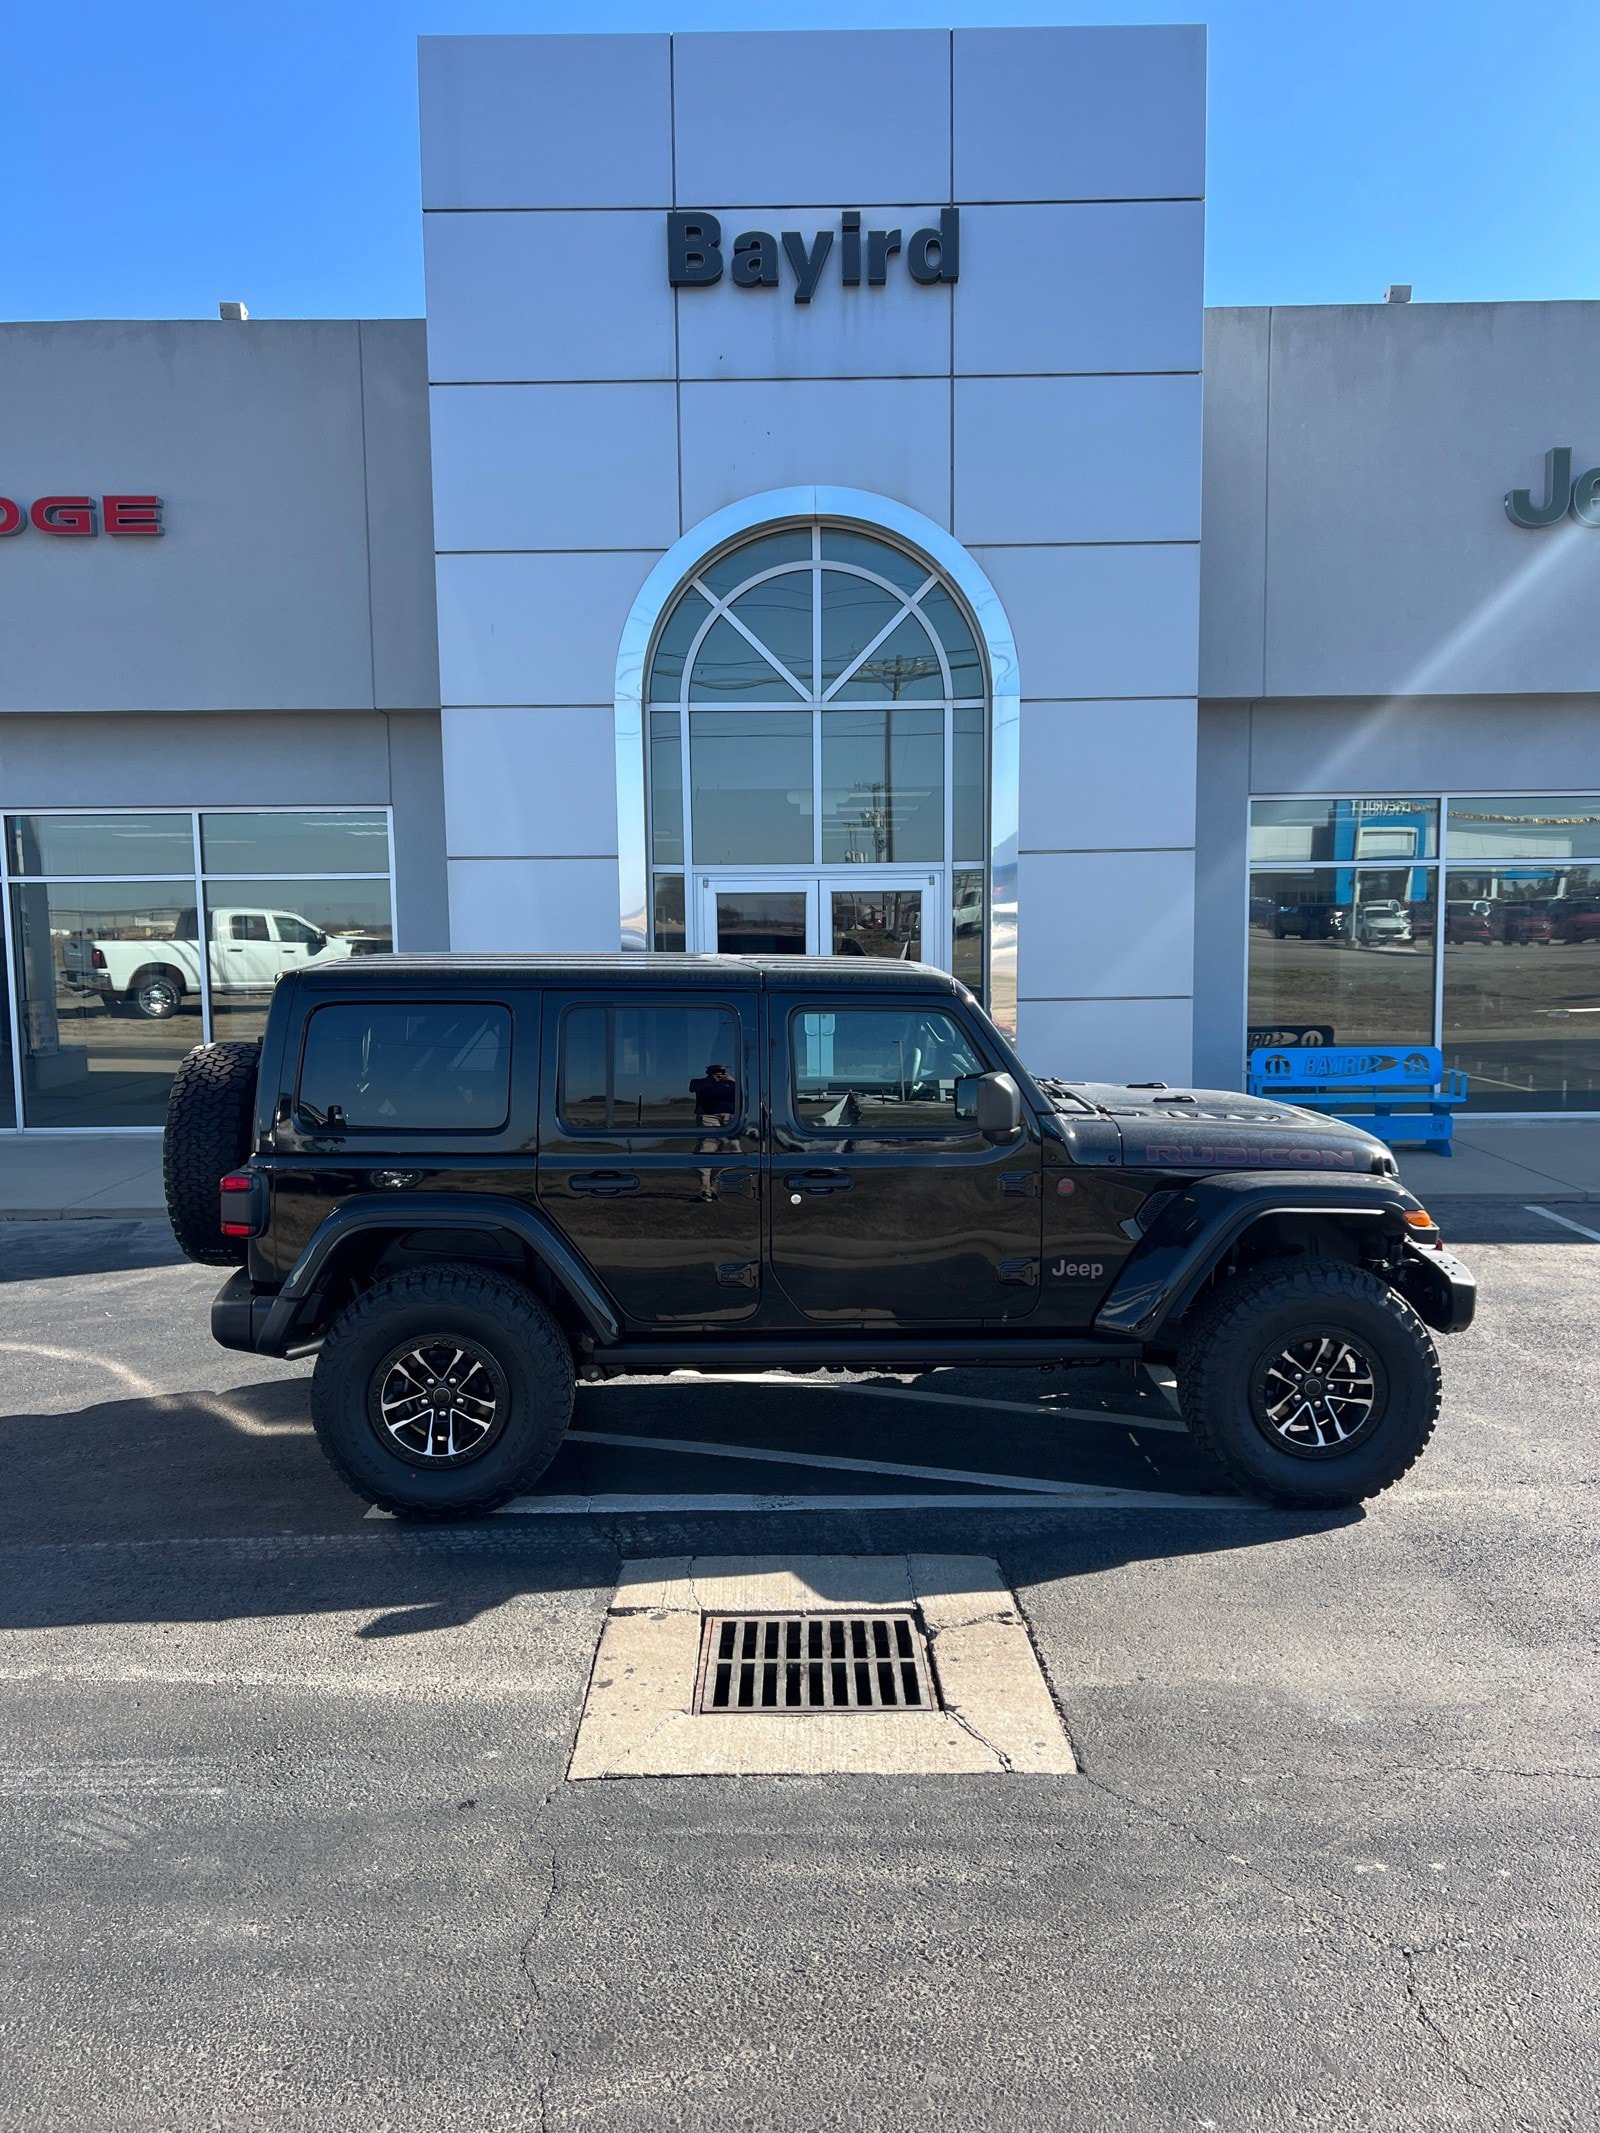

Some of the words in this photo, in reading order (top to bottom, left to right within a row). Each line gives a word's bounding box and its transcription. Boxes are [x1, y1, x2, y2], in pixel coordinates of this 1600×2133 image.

[667, 208, 959, 304] Bayird
[1304, 1056, 1369, 1076] BAYIRD
[1144, 1145, 1354, 1166] RUBICON
[1051, 1259, 1104, 1280] Jeep
